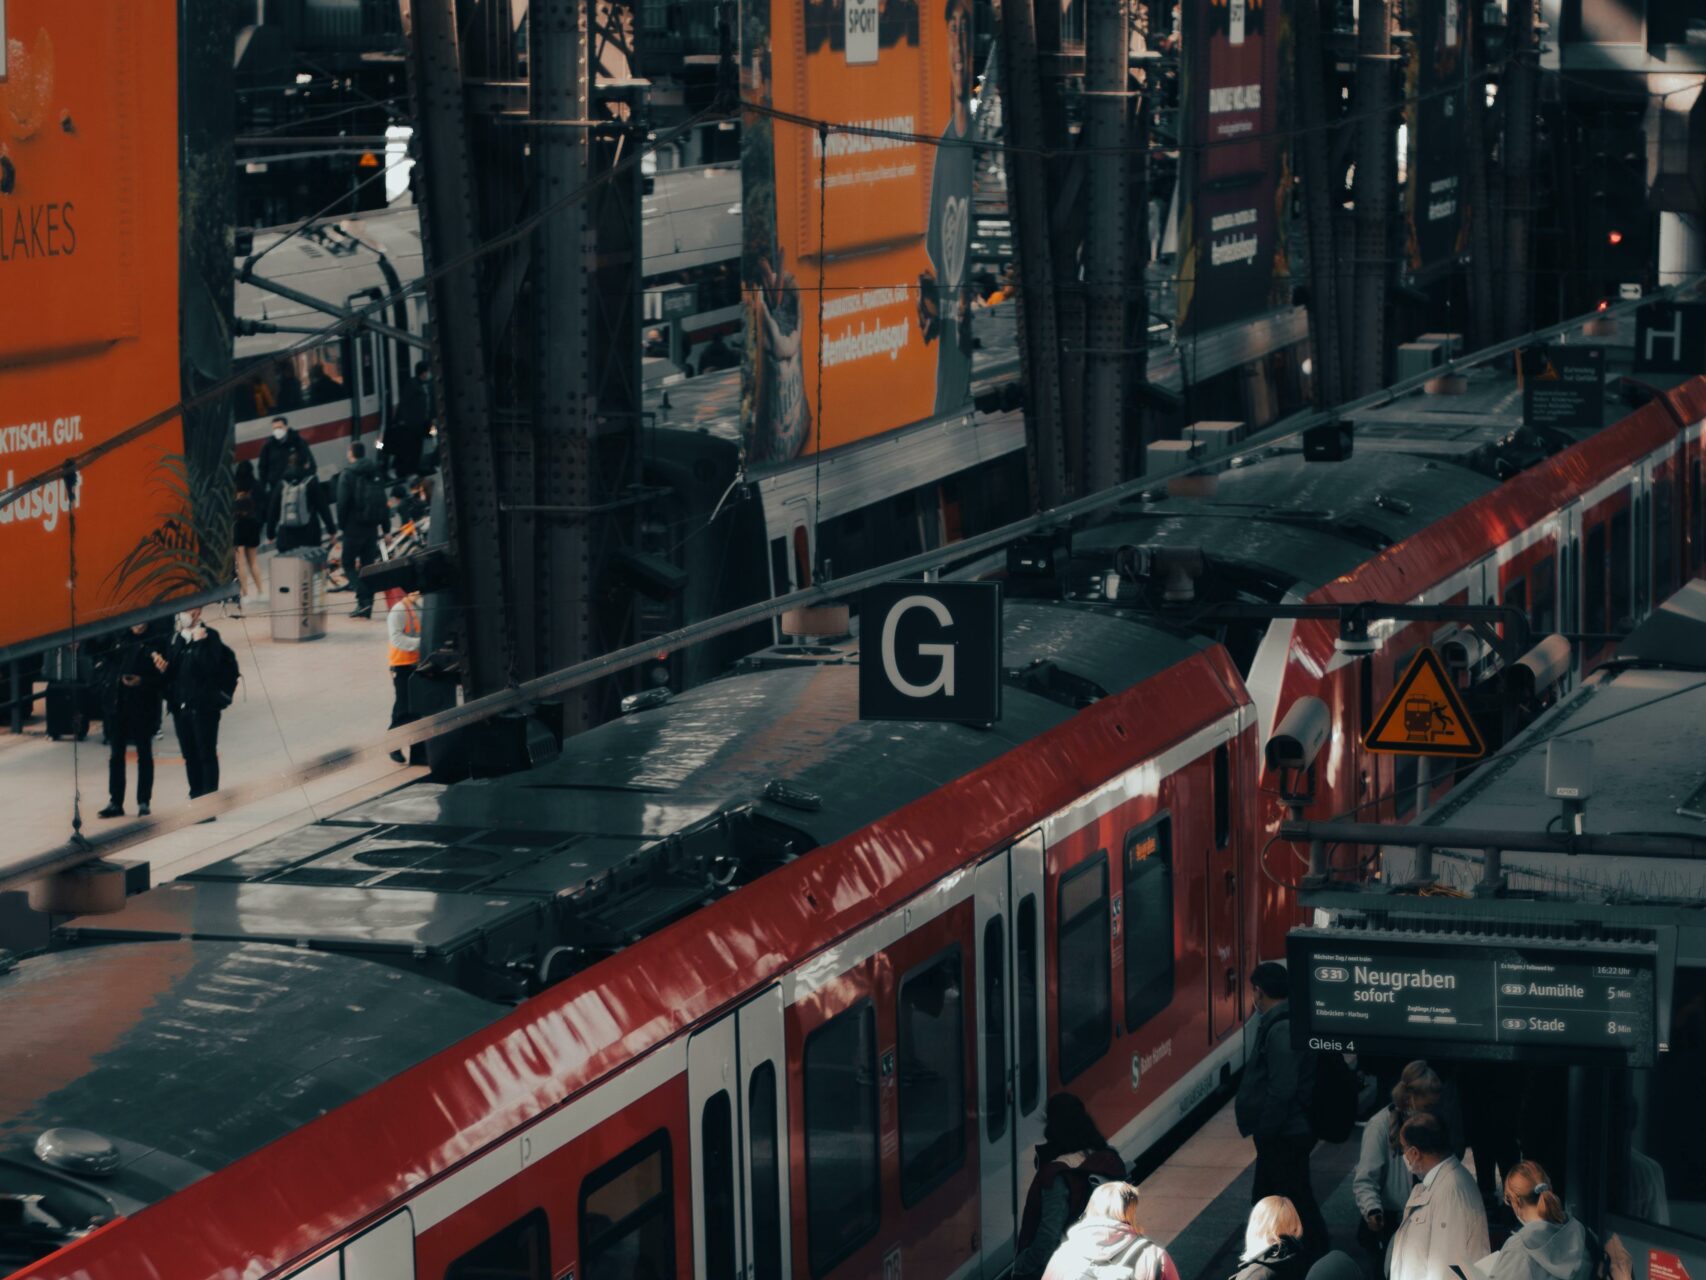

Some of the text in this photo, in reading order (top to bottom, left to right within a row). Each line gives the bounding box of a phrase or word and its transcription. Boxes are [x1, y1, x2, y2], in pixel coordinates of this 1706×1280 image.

[1645, 310, 1682, 361] H
[53, 415, 83, 445] GUT.
[881, 594, 955, 698] G
[1354, 965, 1456, 991] Neugraben
[1618, 967, 1631, 976] Uhr
[1353, 987, 1395, 1003] sofort
[1528, 982, 1584, 998] Aumühle
[1607, 986, 1631, 1000] 5 Min
[1528, 1017, 1565, 1032] Stade
[1607, 1021, 1632, 1034] 8 Min
[1308, 1037, 1355, 1051] Gleis 4
